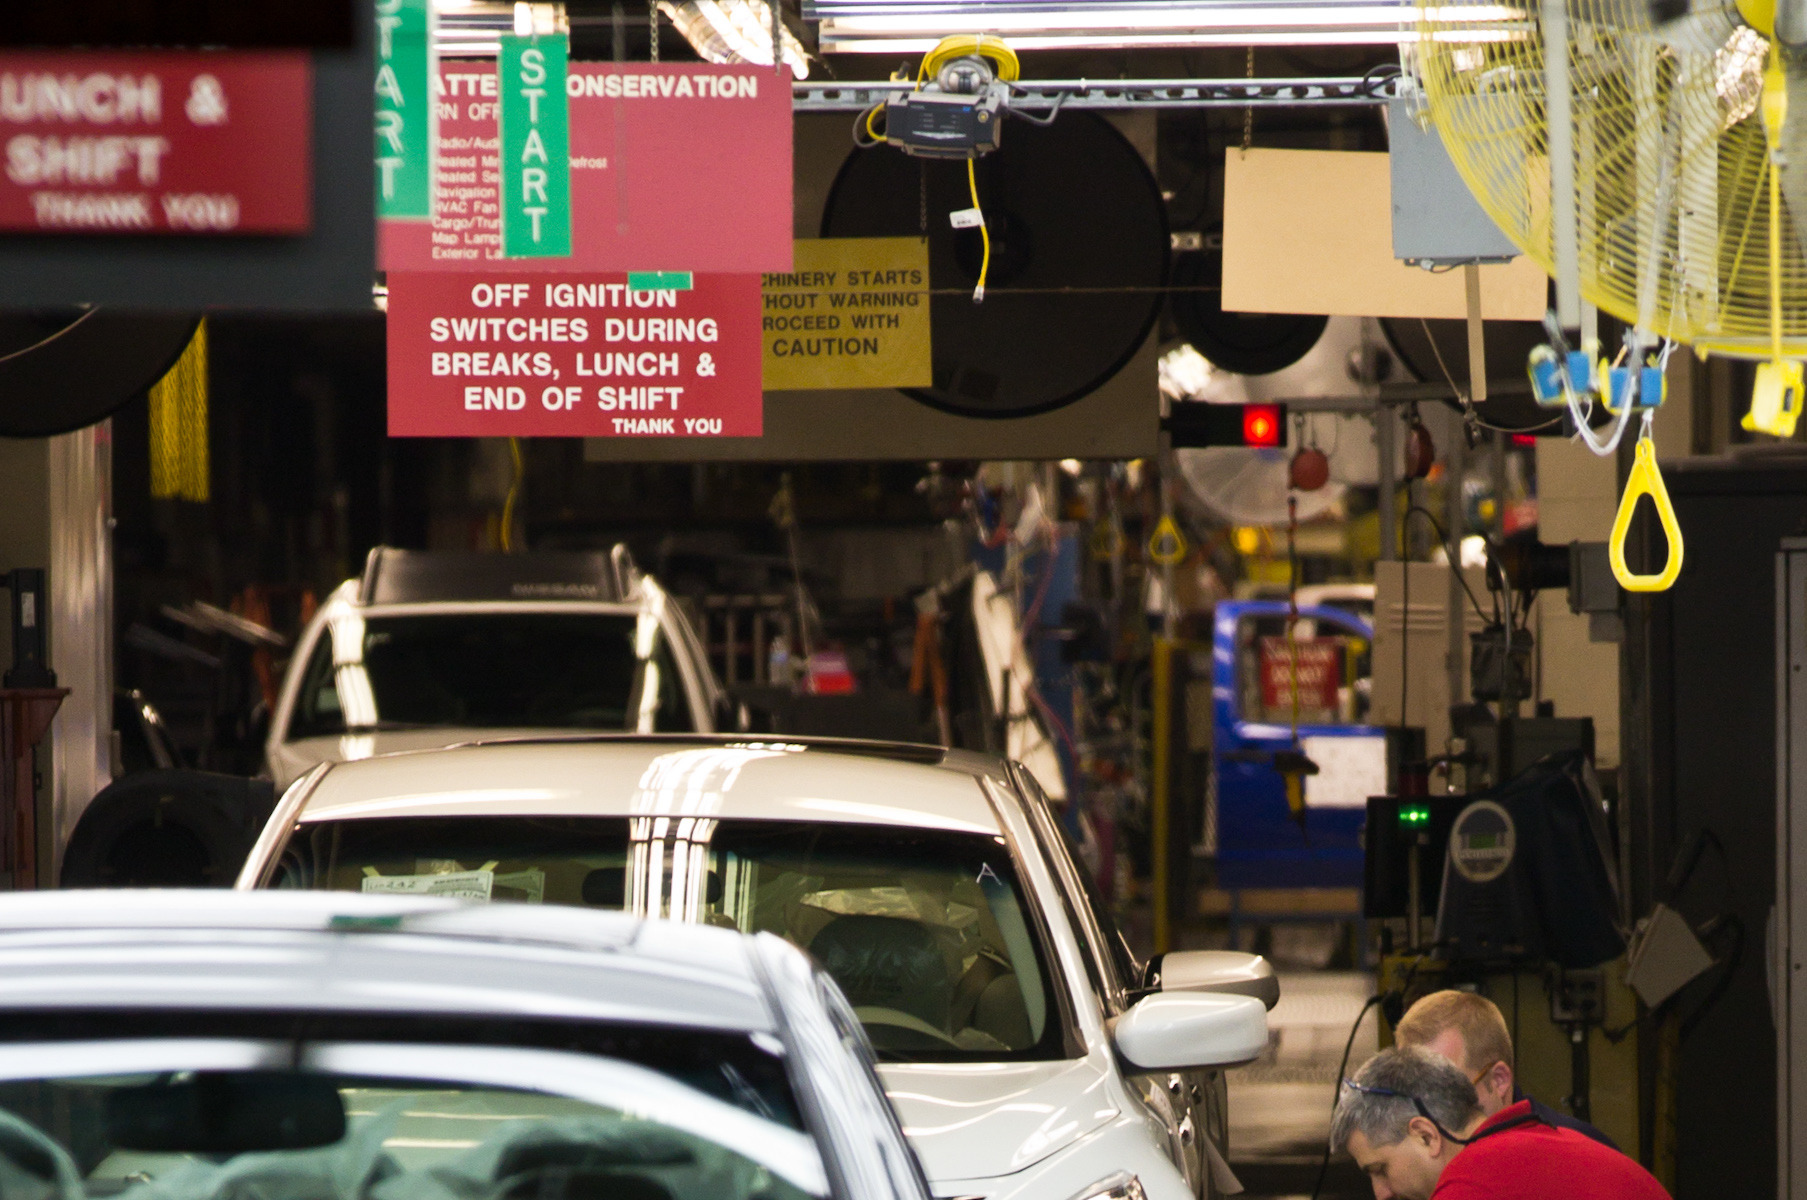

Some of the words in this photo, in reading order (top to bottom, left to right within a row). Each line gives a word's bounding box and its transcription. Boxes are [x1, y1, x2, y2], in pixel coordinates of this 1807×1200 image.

[566, 74, 758, 98] ONSERVATION
[185, 73, 229, 126] &
[519, 49, 549, 243] START
[5, 134, 171, 186] SHIFT
[33, 191, 151, 229] THANK
[161, 192, 241, 230] YOU
[473, 201, 497, 214] Fan
[432, 231, 460, 245] Map
[432, 247, 480, 260] Exterior
[848, 270, 923, 287] STARTS
[471, 283, 530, 308] OFF
[545, 283, 677, 308] IGNITION
[762, 293, 818, 310] HOUT
[829, 292, 919, 309] WARNING
[430, 317, 589, 342] SWITCHES
[605, 318, 719, 343] DURING
[762, 314, 841, 332] ROCEED
[852, 313, 900, 330] WITH
[772, 337, 879, 358] CAUTION
[431, 352, 560, 381] BREAKS,
[576, 352, 679, 377] LUNCH
[695, 352, 717, 377] &
[464, 386, 527, 411] END
[541, 386, 583, 411] OF
[598, 386, 684, 411] SHIFT
[611, 418, 676, 435] THANK
[684, 418, 723, 435] YOU
